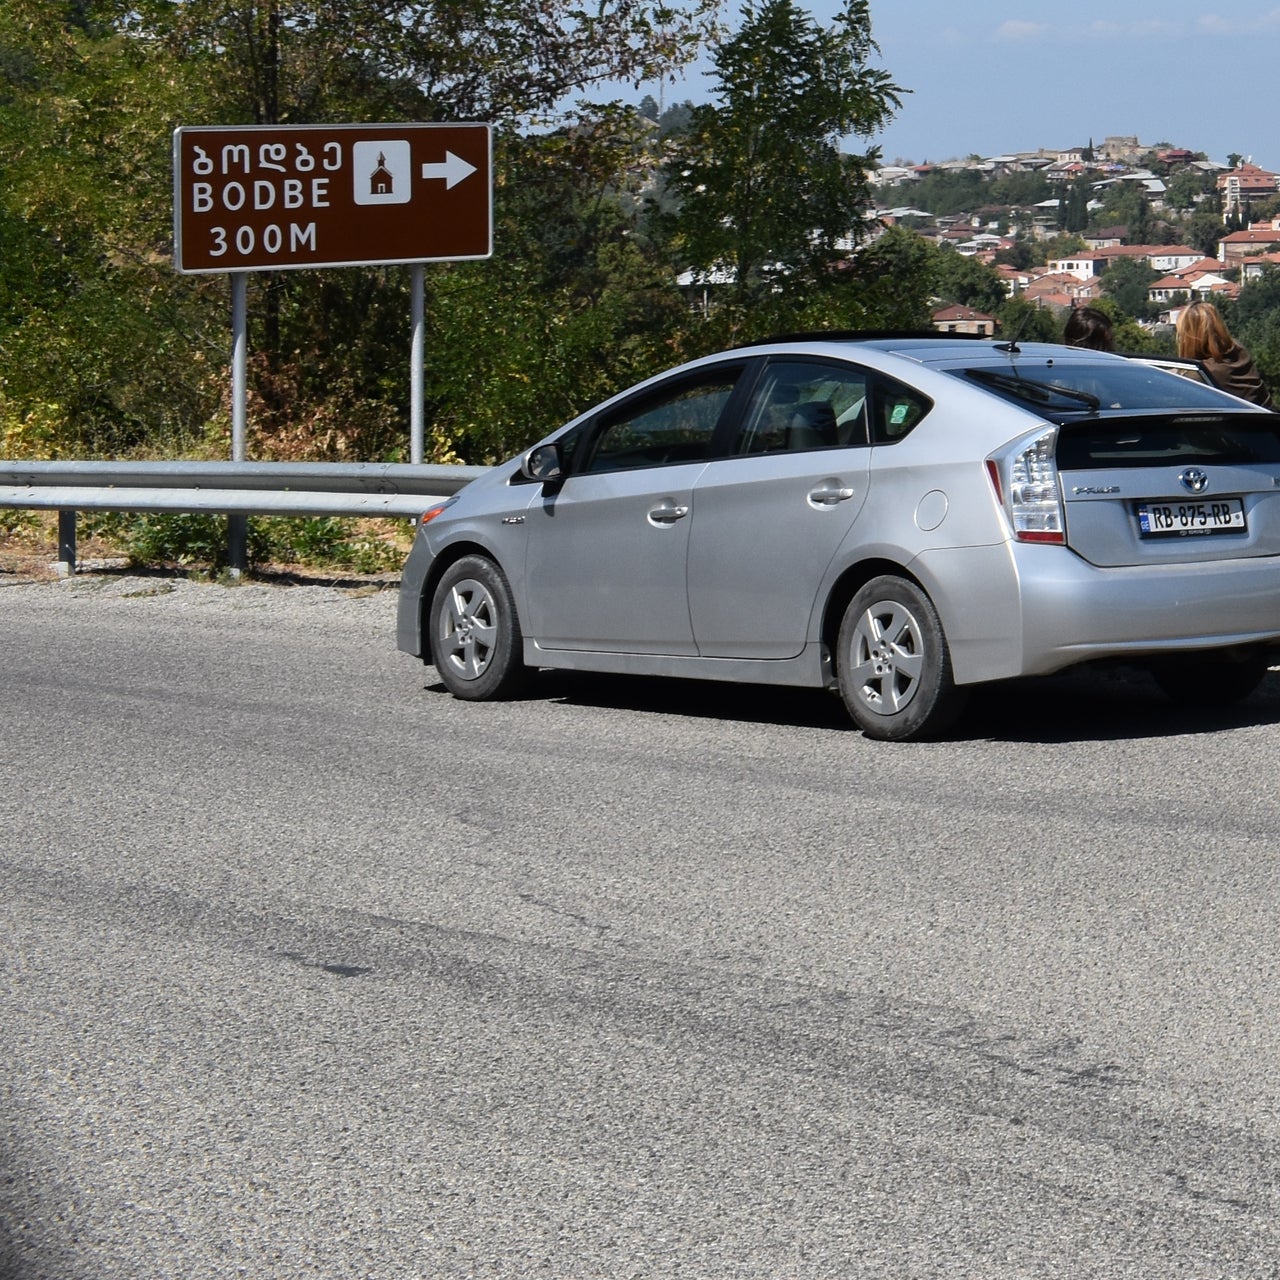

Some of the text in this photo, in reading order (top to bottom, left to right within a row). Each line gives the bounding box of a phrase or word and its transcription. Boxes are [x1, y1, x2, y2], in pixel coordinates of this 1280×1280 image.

[192, 141, 343, 175] ბოდბე
[192, 177, 331, 213] BODBE
[209, 222, 317, 257] 300M
[1152, 503, 1232, 529] RB-875-RB
